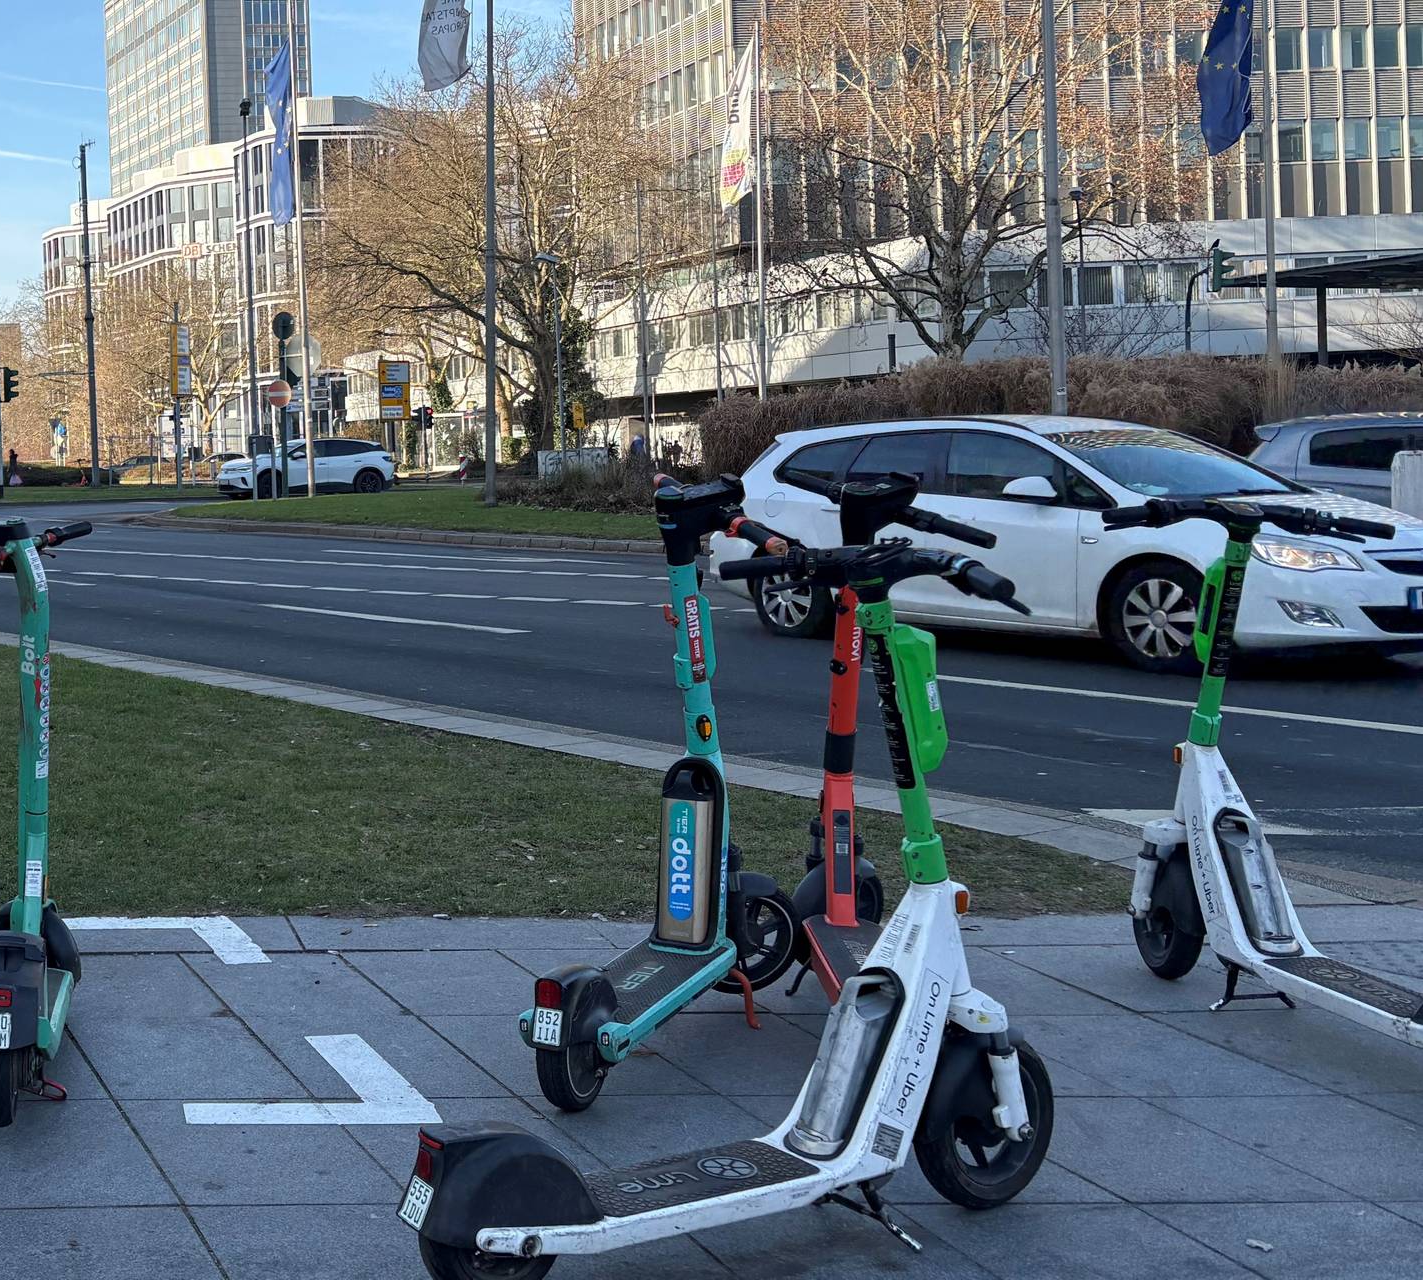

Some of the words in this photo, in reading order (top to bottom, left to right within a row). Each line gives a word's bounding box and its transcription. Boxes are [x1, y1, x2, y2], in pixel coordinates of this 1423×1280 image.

[184, 245, 199, 256] DB
[685, 599, 701, 639] GRATIS
[21, 634, 35, 676] Bolt
[850, 626, 862, 662] movi
[1191, 815, 1198, 836] On
[671, 837, 692, 894] dott
[1194, 837, 1204, 870] Lime
[1203, 881, 1215, 915] Uber
[615, 965, 665, 990] TIER
[928, 981, 940, 1008] On
[538, 1010, 560, 1026] 852
[537, 1027, 557, 1043] IIA
[916, 1011, 936, 1054] Lime
[914, 1059, 921, 1069] +
[896, 1072, 919, 1117] Uber
[410, 1180, 431, 1205] 555
[617, 1171, 700, 1193] Lime
[402, 1199, 424, 1224] IDU
